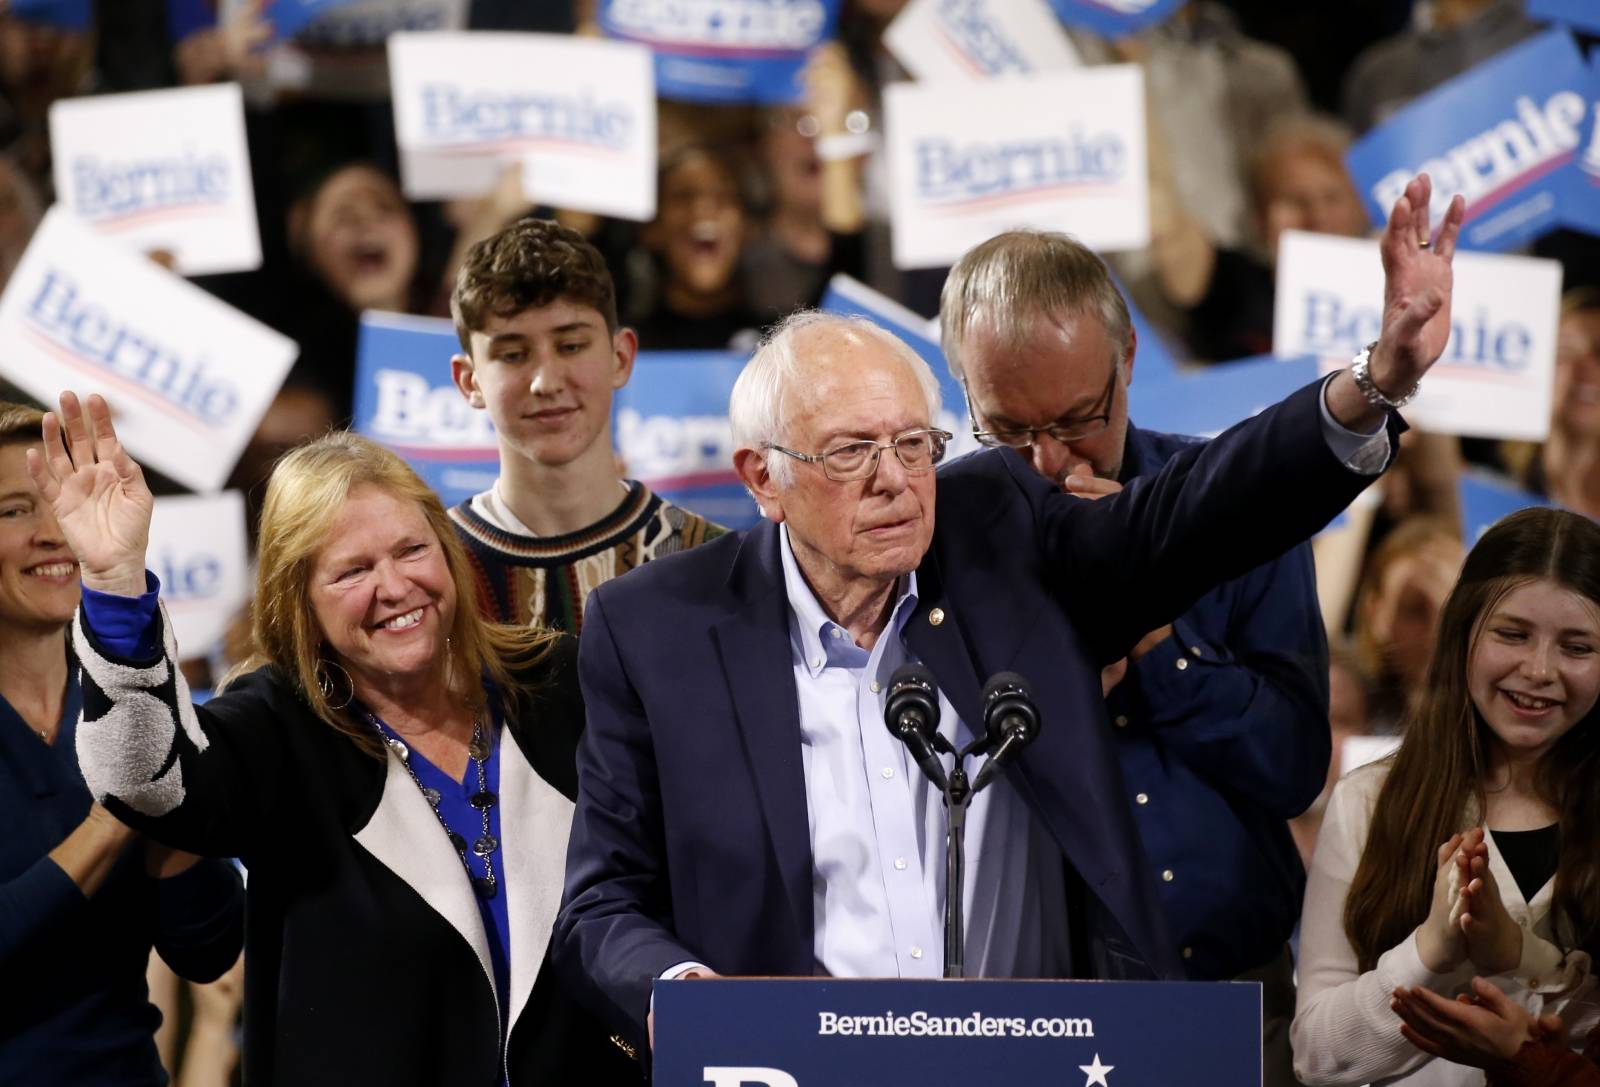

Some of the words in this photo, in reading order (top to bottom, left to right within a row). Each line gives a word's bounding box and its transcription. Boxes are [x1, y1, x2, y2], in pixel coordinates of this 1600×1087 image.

[420, 83, 634, 150] Bernie
[73, 145, 230, 217] Bernie
[914, 125, 1128, 198] Bernie
[26, 267, 241, 429] Bernie
[818, 1010, 1095, 1038] BernieSanders.com
